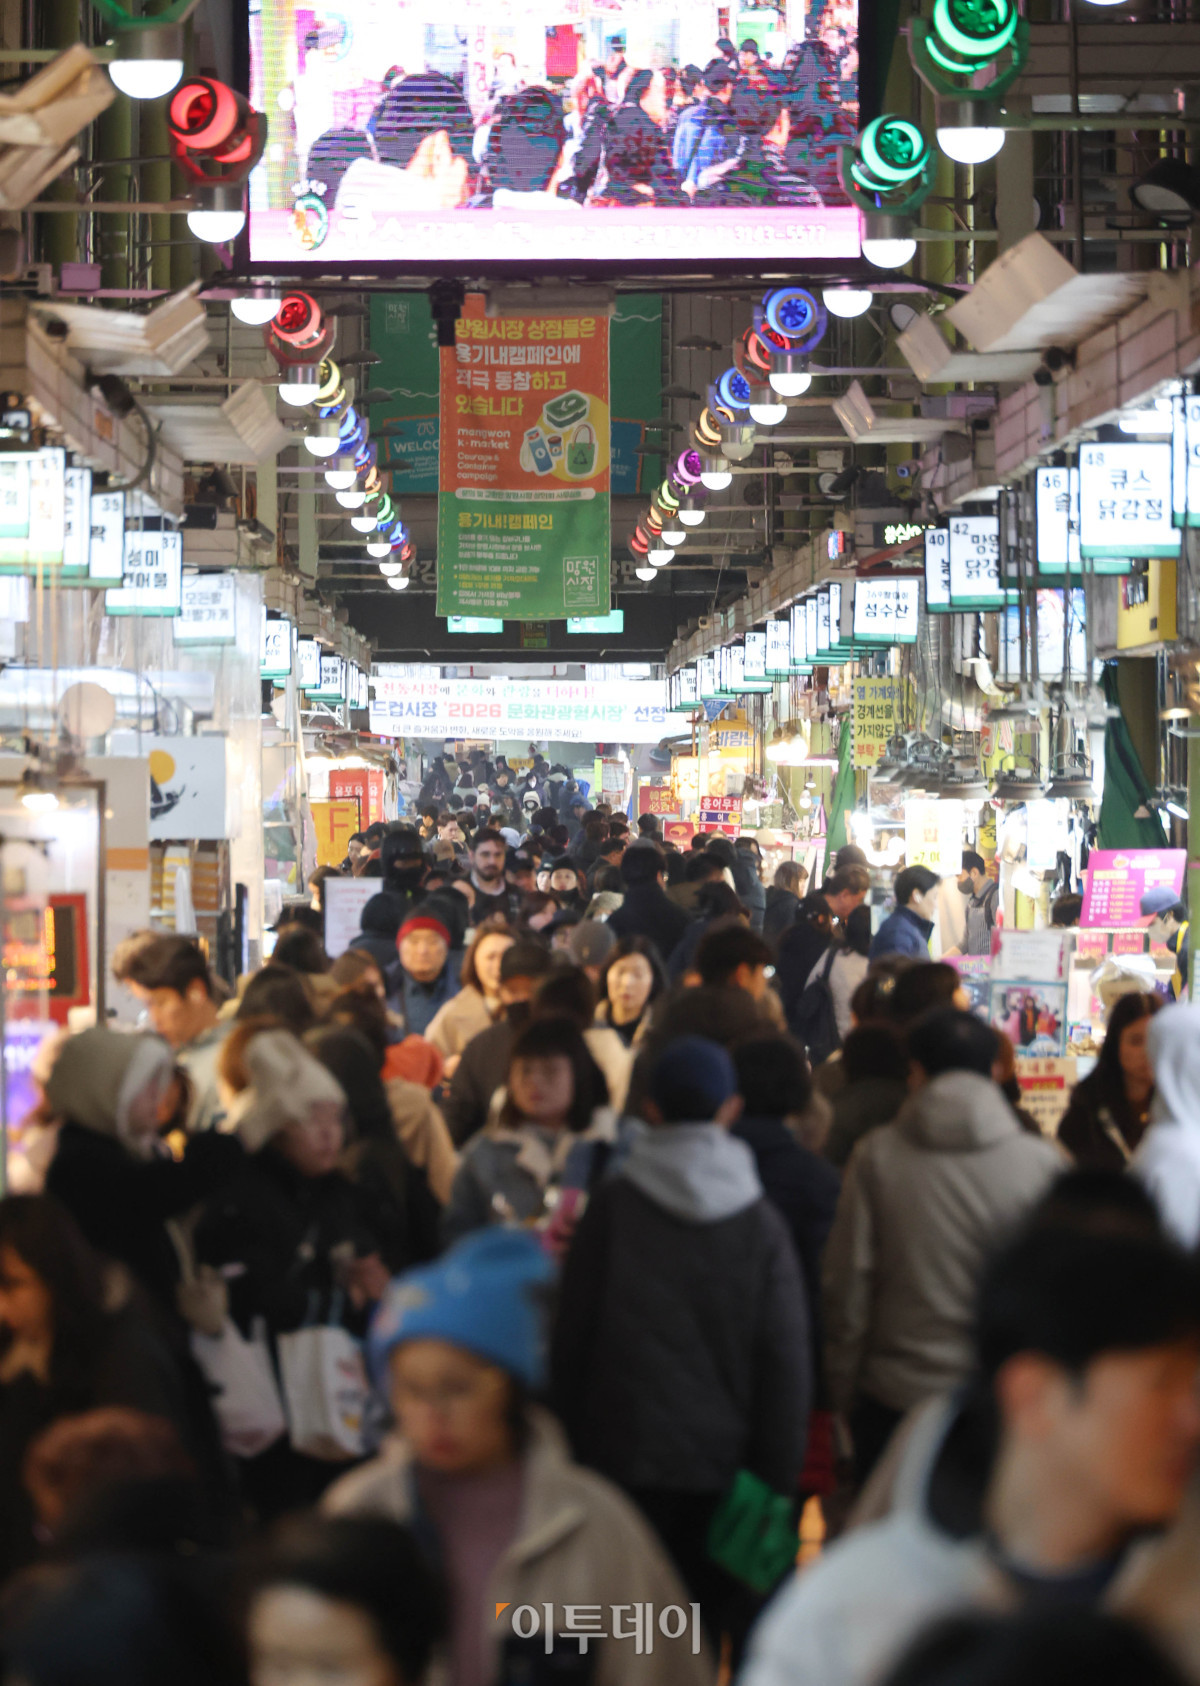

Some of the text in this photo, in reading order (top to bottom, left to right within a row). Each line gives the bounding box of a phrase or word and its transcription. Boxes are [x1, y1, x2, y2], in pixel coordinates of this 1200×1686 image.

[454, 317, 596, 340] 망원시장 상점들은
[455, 343, 581, 366] 용기내캠페인에
[456, 368, 567, 391] 적극 동참하고
[455, 394, 525, 416] 있습니다
[457, 427, 511, 439] mangwon
[457, 451, 493, 462] Courage
[1085, 452, 1105, 466] 48
[456, 462, 498, 471] Container
[456, 471, 499, 481] campaign
[1042, 474, 1062, 489] 46
[1109, 468, 1152, 491] 큐스
[1098, 499, 1163, 521] 닭강정
[457, 511, 553, 530] 용기내!캠페인
[953, 523, 970, 536] 42
[162, 536, 177, 549] 37
[928, 534, 945, 546] 40
[565, 559, 596, 576] 망원
[565, 576, 596, 592] 시장
[864, 603, 909, 619] 섬수산
[746, 634, 756, 643] 24
[633, 705, 667, 724] 선정
[857, 704, 893, 720] 경계선을
[856, 743, 875, 758] 부탁
[702, 798, 741, 811] 홍어무침
